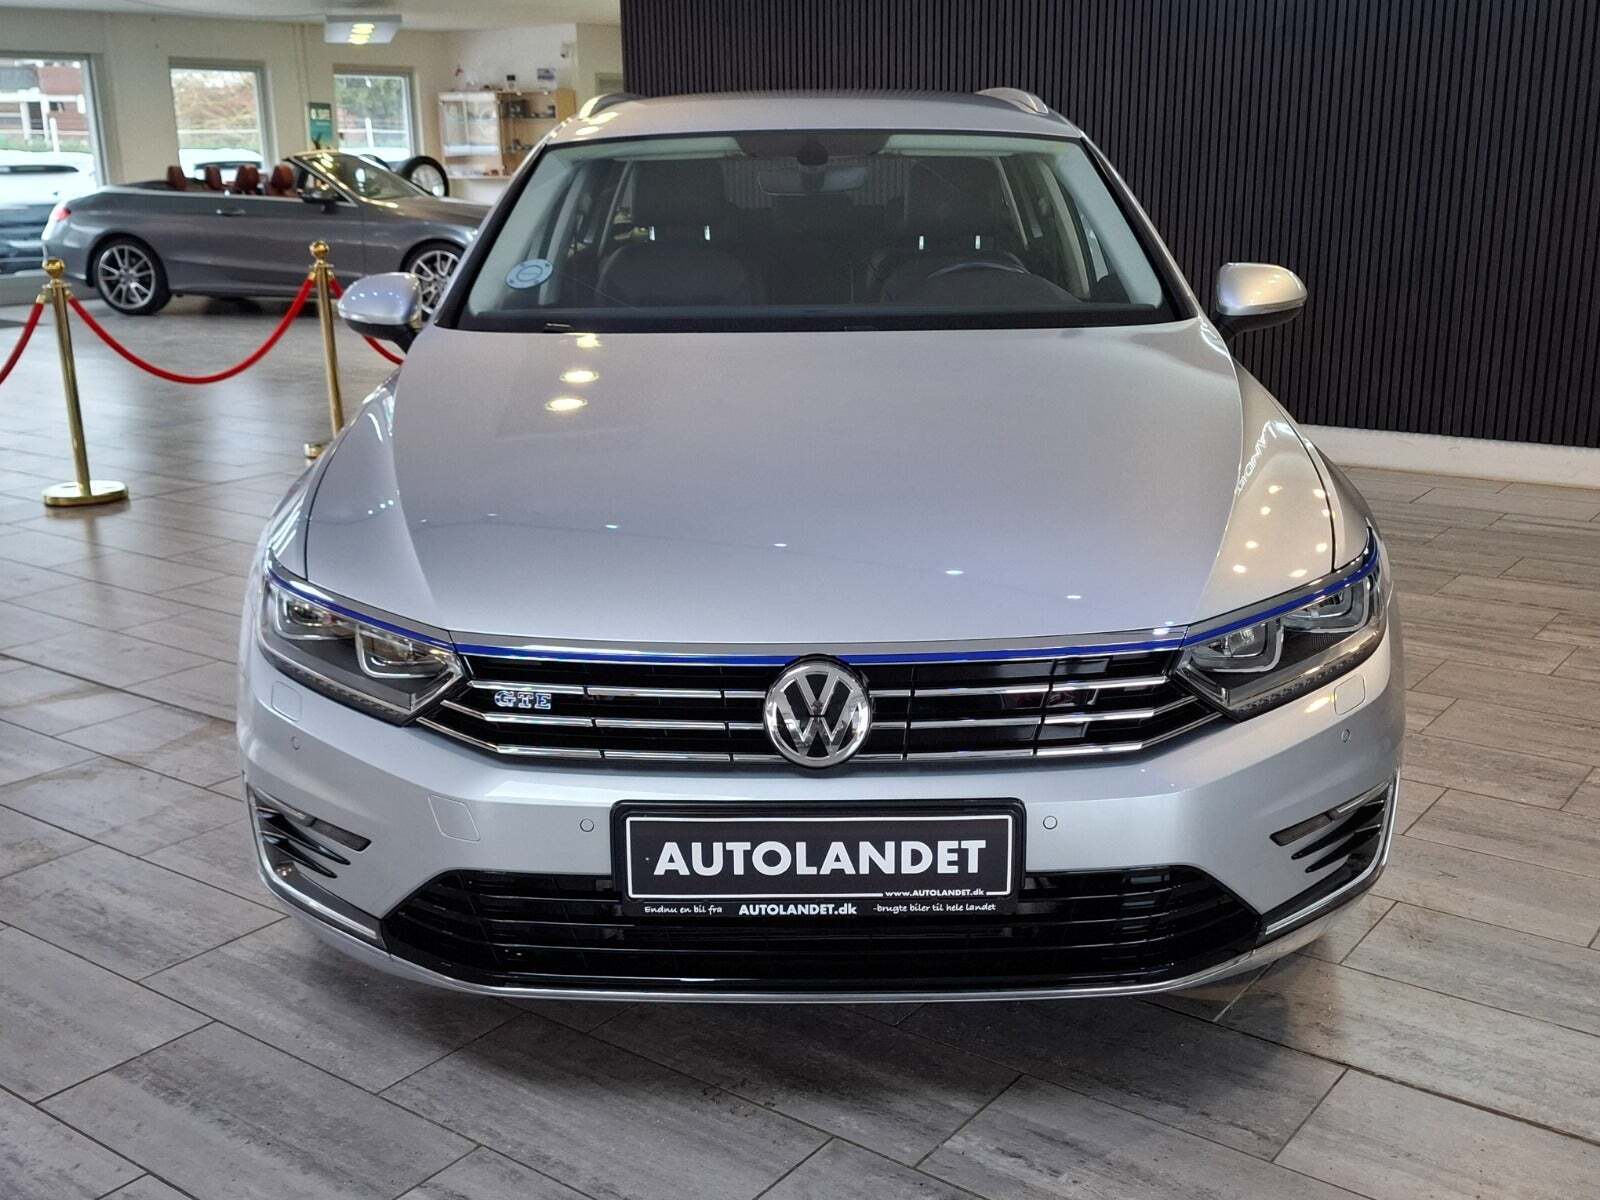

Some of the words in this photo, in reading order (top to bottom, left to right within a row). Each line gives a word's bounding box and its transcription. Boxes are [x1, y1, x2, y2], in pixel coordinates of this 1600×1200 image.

[494, 690, 552, 710] GTE
[653, 840, 987, 876] AUTOLANDET
[885, 889, 985, 898] www.AUTOLANDET.dk
[644, 905, 678, 914] Endnu
[679, 906, 692, 914] en
[693, 904, 707, 914] bil
[708, 904, 723, 916] fra
[738, 903, 858, 916] AUTOLANDET.dk
[909, 903, 931, 912] biler
[932, 902, 944, 912] til
[946, 902, 964, 912] hele
[965, 902, 997, 912] landet
